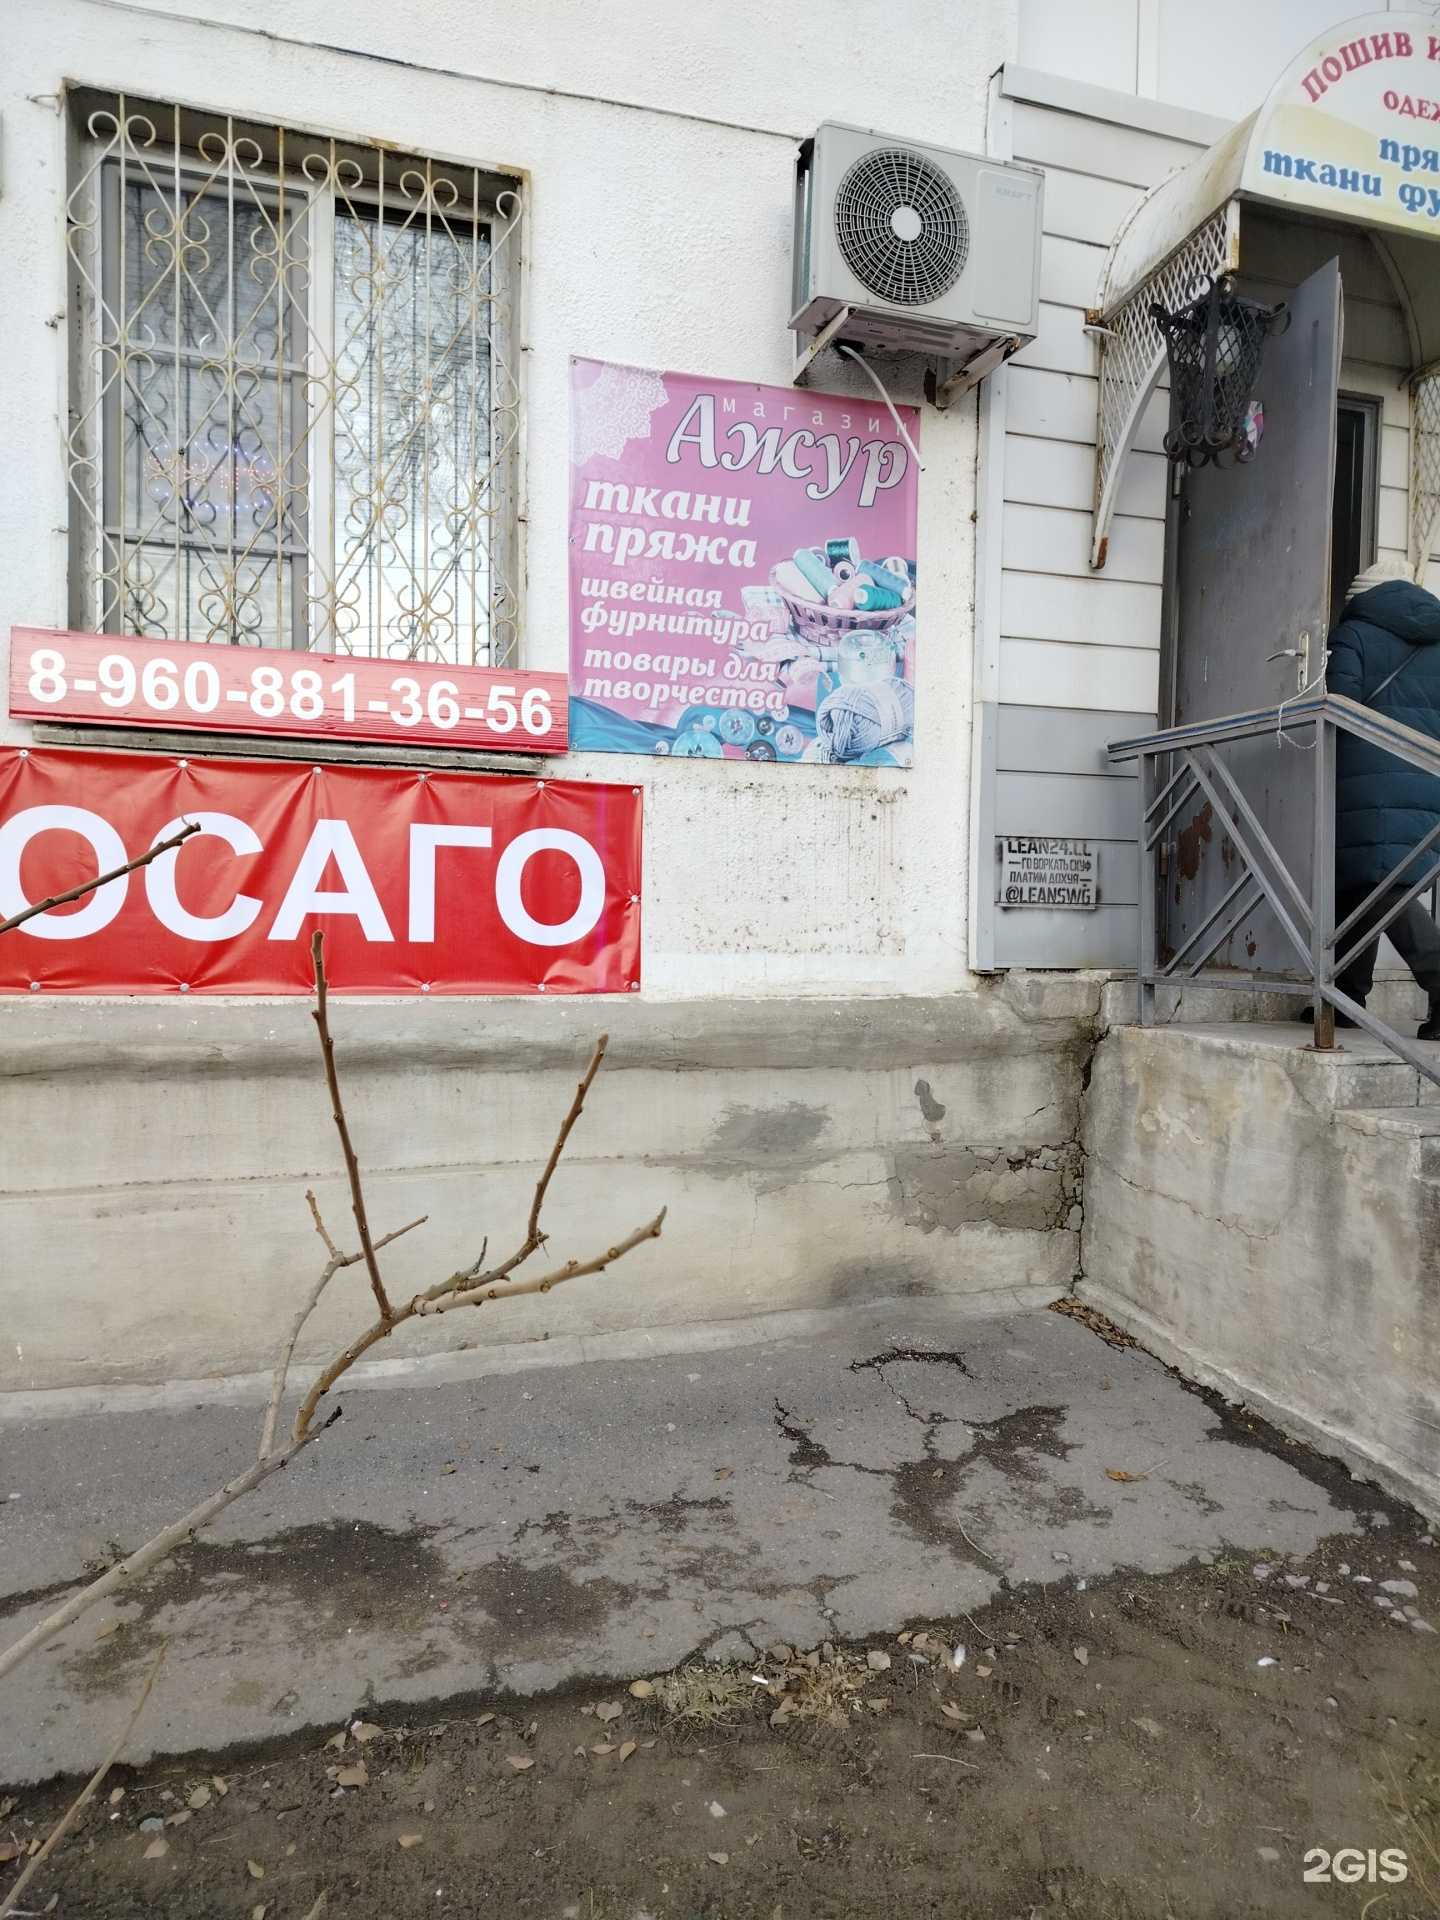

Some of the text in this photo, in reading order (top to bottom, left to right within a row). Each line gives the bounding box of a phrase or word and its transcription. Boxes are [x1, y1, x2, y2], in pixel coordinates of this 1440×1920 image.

[1301, 31, 1413, 103] ПОШИВ
[1263, 150, 1382, 197] ткани
[666, 393, 909, 508] Ажур
[583, 478, 751, 527] ткани
[583, 521, 757, 568] пряжа
[581, 577, 722, 609] швейная
[581, 602, 770, 645] фурнитура
[583, 648, 780, 682] товары для
[27, 648, 553, 736] 8-960-881-36-56
[583, 676, 784, 711] творчества
[0, 804, 607, 947] ОСАГО
